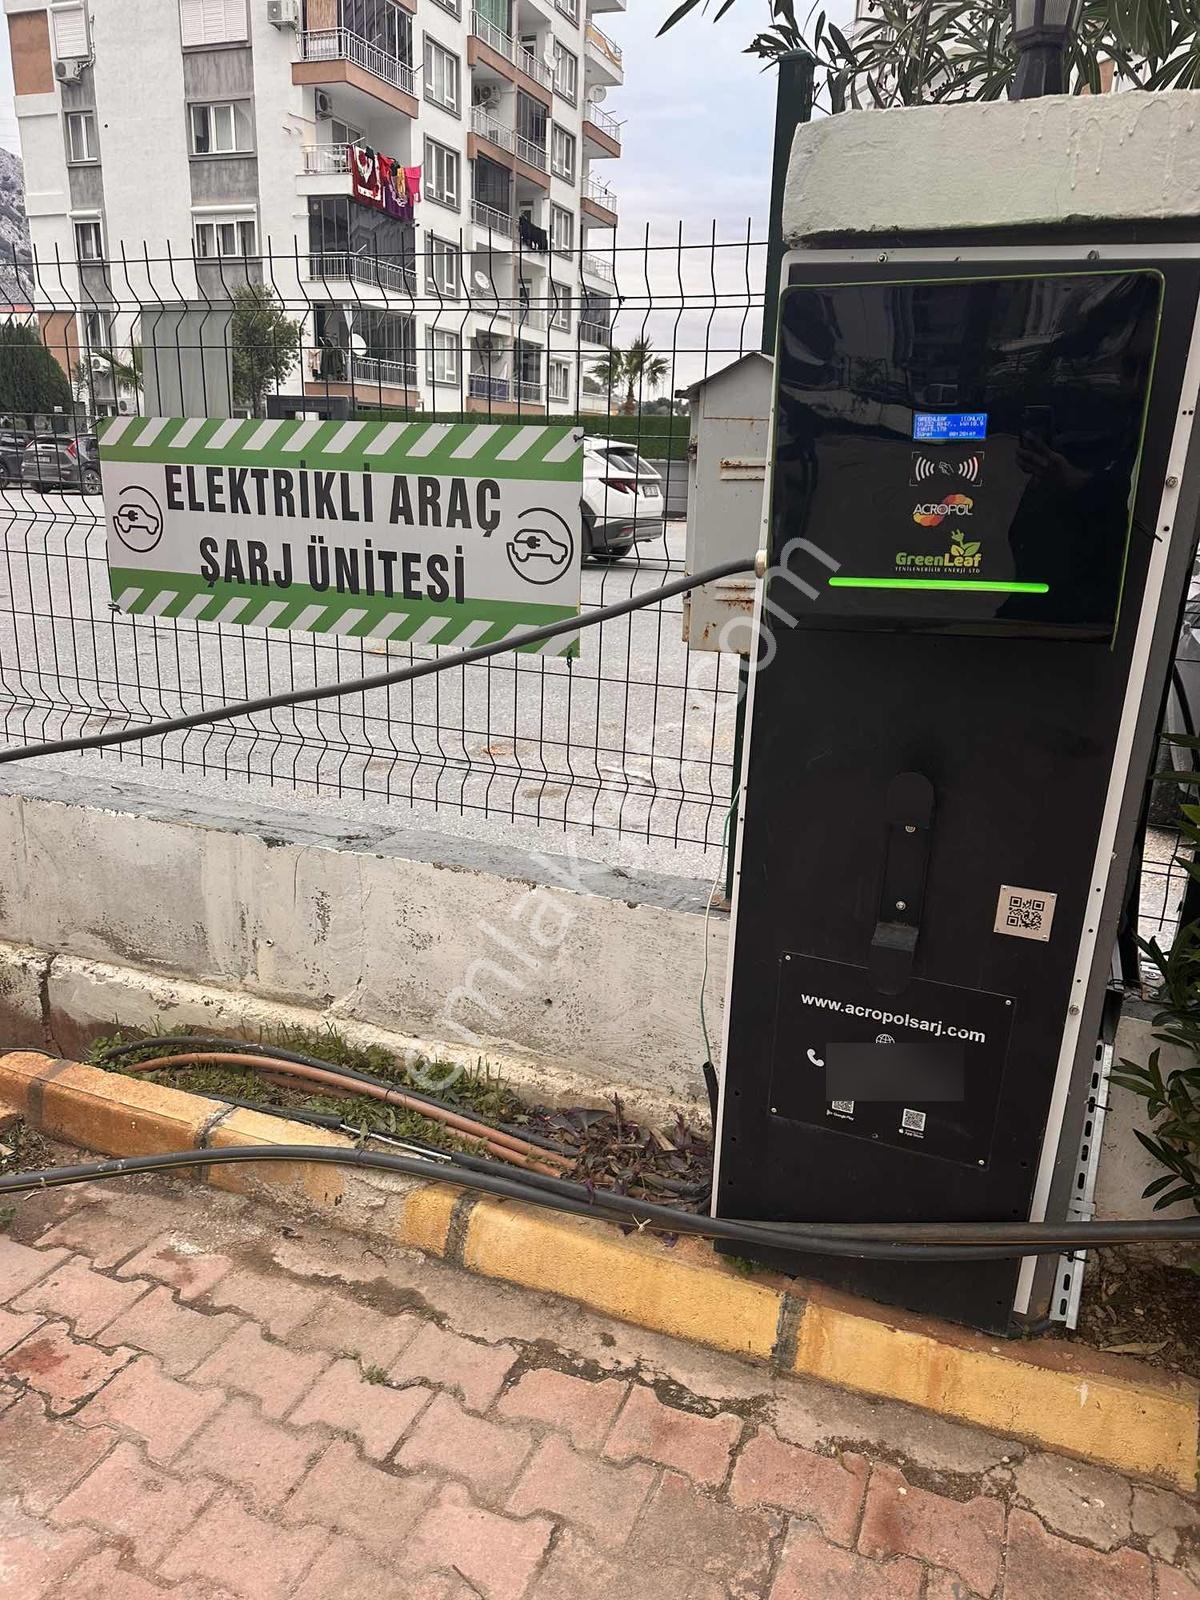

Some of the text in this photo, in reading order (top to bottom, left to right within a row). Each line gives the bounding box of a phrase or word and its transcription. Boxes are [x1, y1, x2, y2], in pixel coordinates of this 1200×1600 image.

[164, 460, 501, 537] ELEKTRİKLİ ARAÇ
[913, 503, 973, 516] ACROPOL
[199, 534, 465, 604] ŞARJ ÜNİTESİ
[895, 551, 982, 567] GreenLeaf
[800, 993, 987, 1044] www.acropolsarj.com
